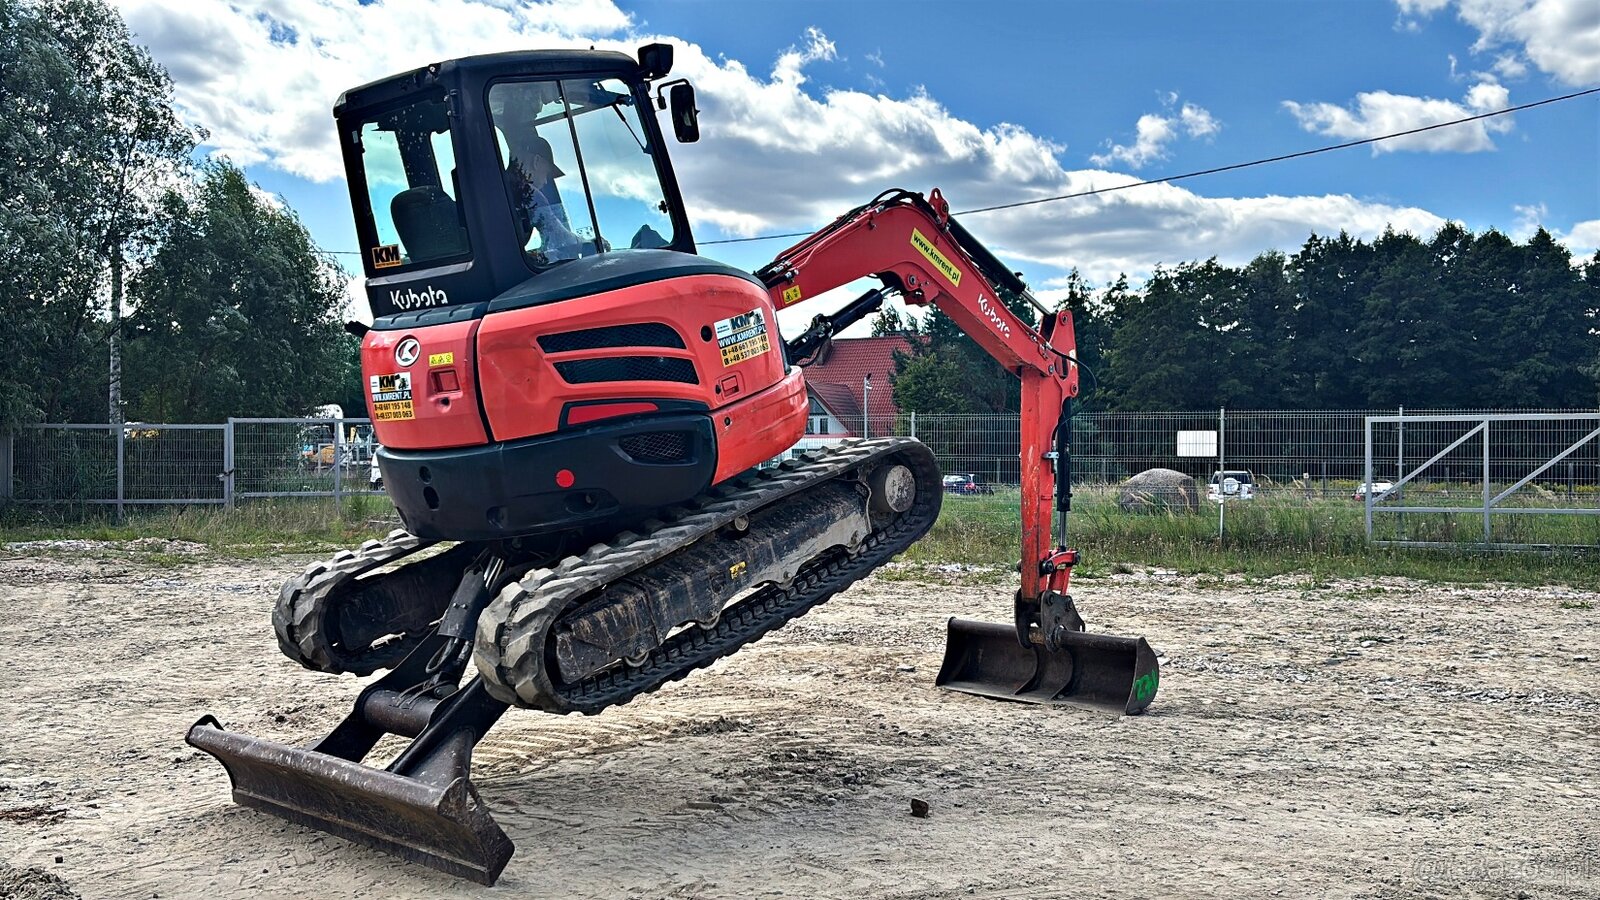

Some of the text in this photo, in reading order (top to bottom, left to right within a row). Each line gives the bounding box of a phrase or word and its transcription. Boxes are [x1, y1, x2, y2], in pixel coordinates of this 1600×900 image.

[374, 246, 399, 263] KM
[913, 234, 959, 282] www.kmrent.pl
[390, 285, 448, 310] Kubota
[730, 313, 751, 330] KM
[977, 293, 1010, 338] Kubota
[379, 375, 395, 388] KM
